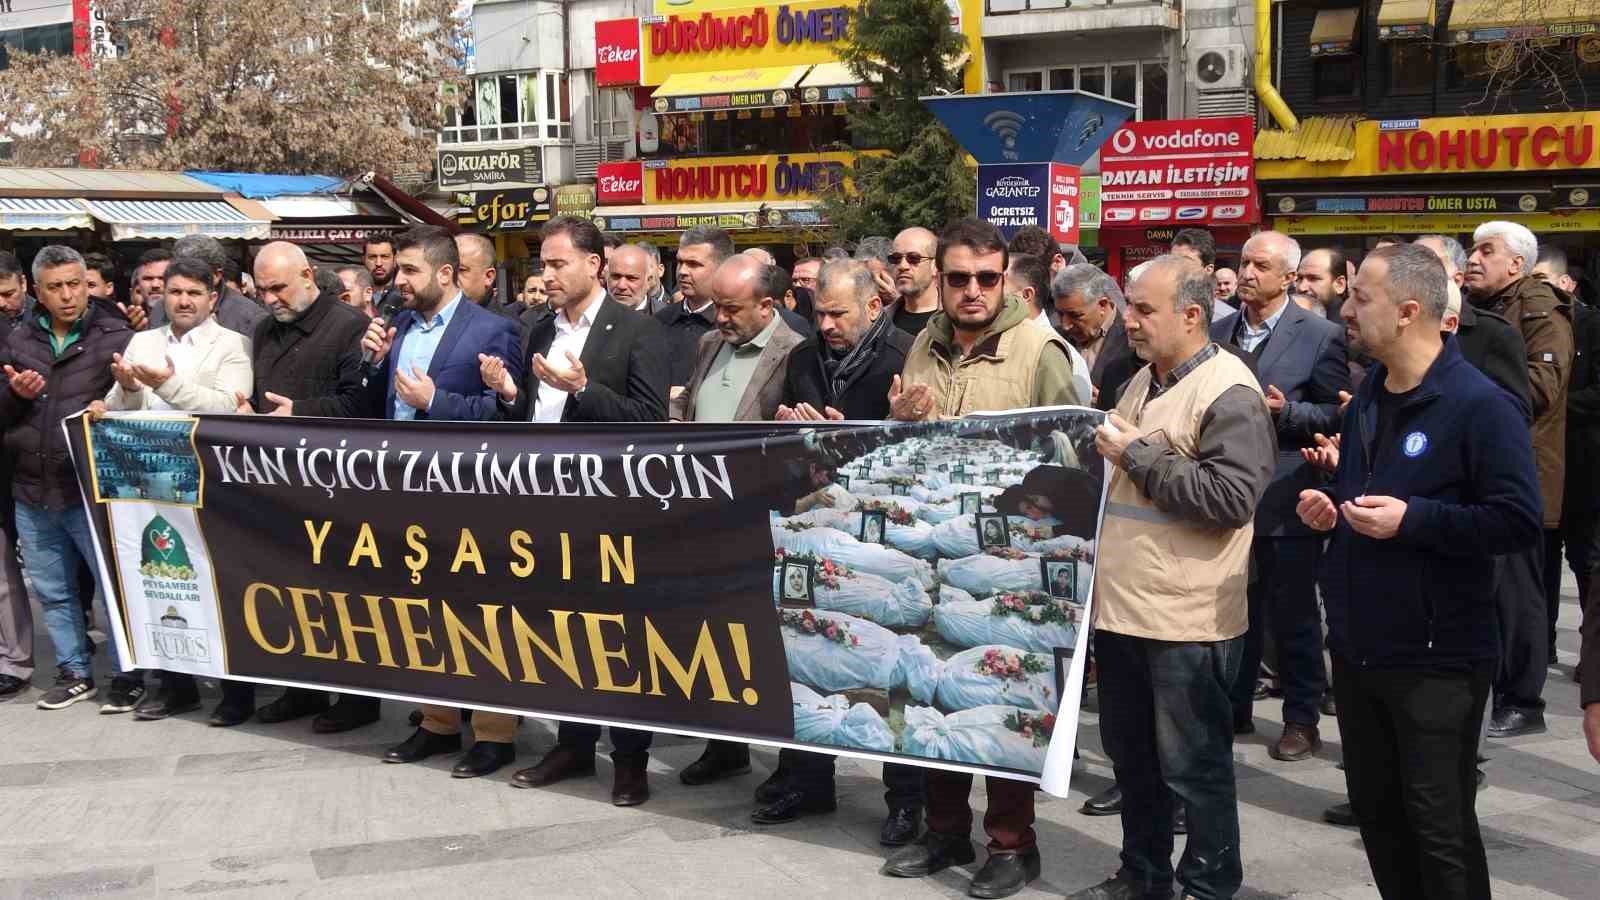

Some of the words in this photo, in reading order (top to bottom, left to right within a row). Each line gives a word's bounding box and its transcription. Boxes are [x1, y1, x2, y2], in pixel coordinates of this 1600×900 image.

[651, 7, 769, 57] DÜRÜMCÜ
[776, 5, 849, 47] ÖMER
[598, 45, 637, 64] Teker
[731, 94, 749, 106] ÖMER
[751, 93, 765, 105] USTA
[1143, 128, 1240, 149] vodafone
[1378, 124, 1594, 171] NOHUTCU
[458, 152, 521, 171] KUAFÖR
[473, 170, 506, 181] SAMİRA
[600, 175, 640, 193] Teker
[655, 164, 768, 200] NOHUTCU
[774, 155, 845, 196] ÖMER
[1102, 169, 1163, 186] DAYAN
[1167, 162, 1250, 187] İLETİŞİM
[477, 193, 529, 231] efor
[1427, 196, 1462, 210] ÖMER
[1466, 197, 1497, 210] USTA
[677, 216, 697, 227] ÖMER
[328, 229, 352, 241] ÇAY
[1146, 229, 1174, 240] DAYAN
[211, 445, 292, 487] KAN
[296, 438, 391, 499] İÇİCİ
[399, 442, 617, 498] ZALİMLER
[620, 443, 735, 511] İÇİN
[303, 519, 636, 585] YAŞASIN
[143, 579, 199, 592] PEYGAMBER
[243, 582, 759, 706] CEHENNEM!
